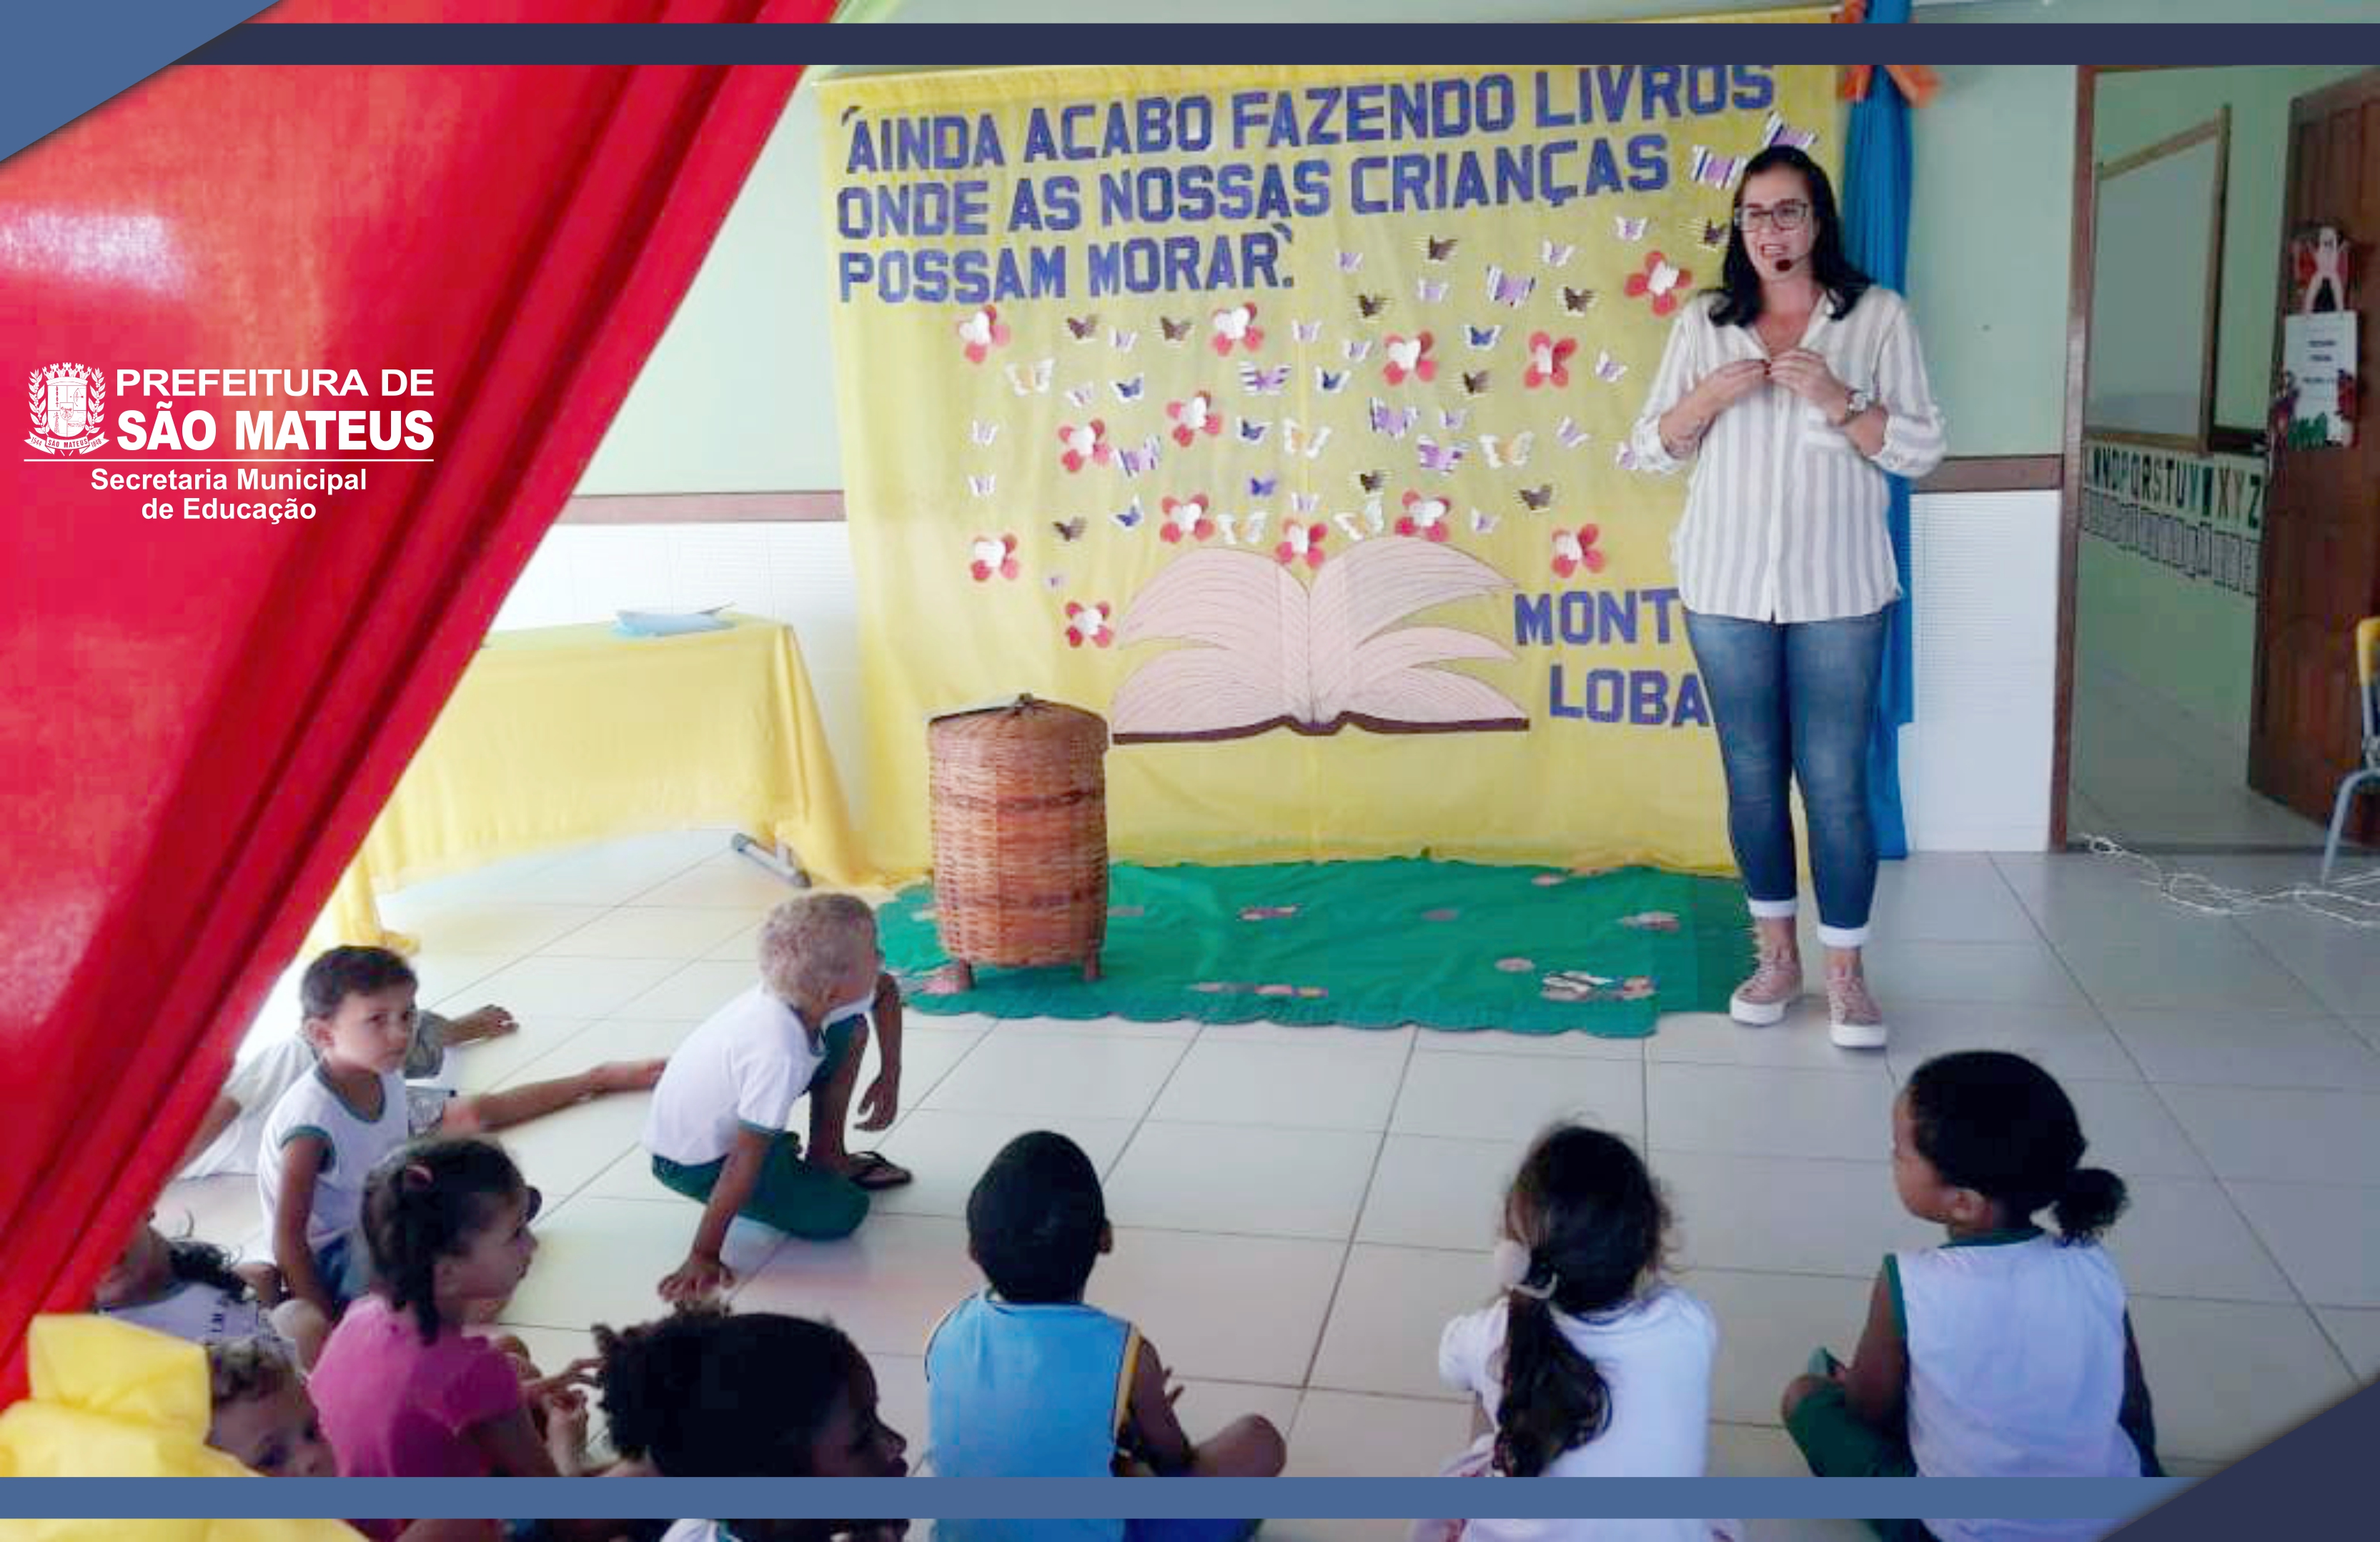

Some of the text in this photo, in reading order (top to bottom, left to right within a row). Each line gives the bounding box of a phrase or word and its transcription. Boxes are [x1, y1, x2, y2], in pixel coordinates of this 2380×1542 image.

[1024, 95, 1214, 164] ACABO
[1232, 74, 1515, 150] FAZENDO
[1535, 65, 1774, 128] LIVROS
[838, 134, 1669, 239] ONDE AS NOSSAS CRIANÇAS
[840, 246, 1066, 304] POSSAM
[1514, 587, 1679, 646] MONT
[1550, 664, 1710, 727] LOBA
